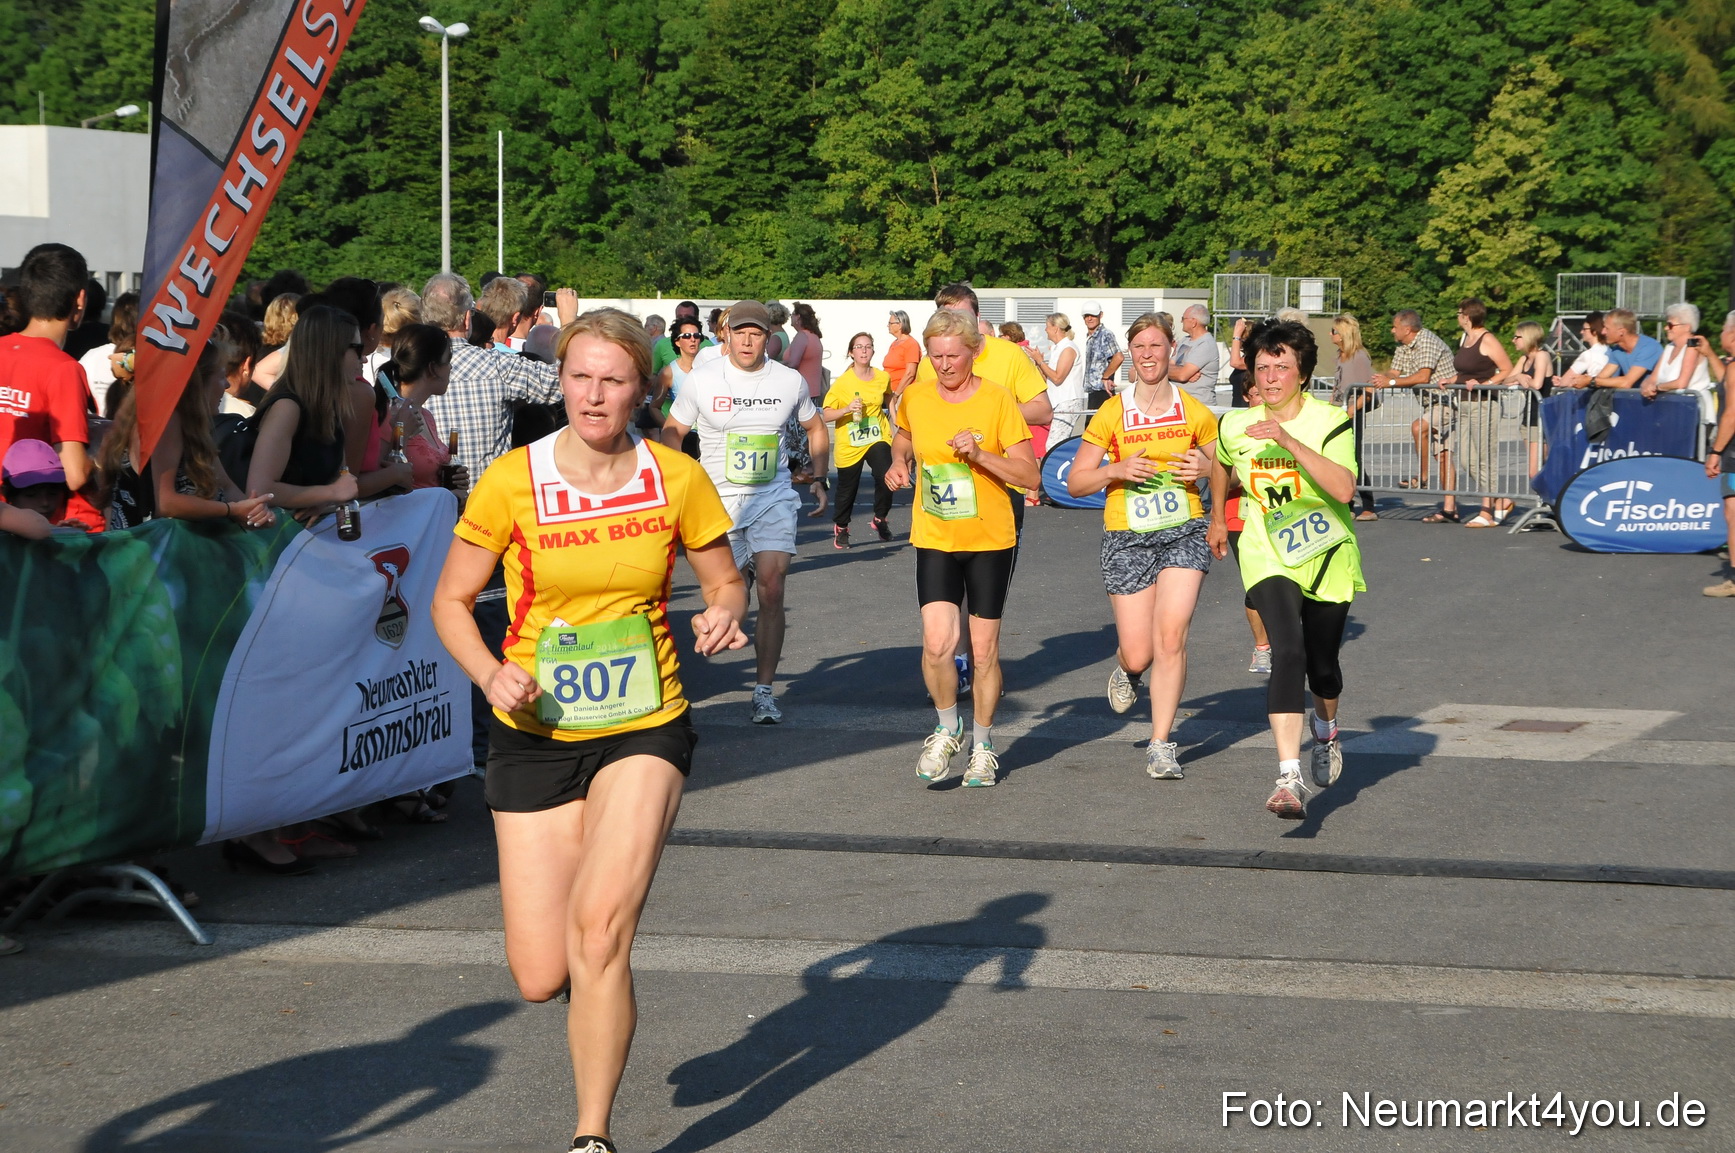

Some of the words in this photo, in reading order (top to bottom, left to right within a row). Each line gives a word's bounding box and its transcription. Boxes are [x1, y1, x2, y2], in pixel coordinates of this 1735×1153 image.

[142, 0, 353, 353] WECHSELS
[733, 397, 782, 407] Egner
[849, 425, 880, 441] 1270
[1123, 431, 1153, 444] MAX
[1157, 428, 1190, 441] BÖGL
[733, 451, 769, 471] 311
[1250, 457, 1298, 470] Müller
[930, 483, 958, 506] 54
[1133, 491, 1179, 518] 818
[1264, 485, 1292, 509] M
[1605, 498, 1720, 520] Fischer
[538, 528, 600, 550] MAX
[607, 515, 672, 541] BÖGL
[1278, 511, 1330, 554] 278
[1615, 521, 1711, 532] AUTOMOBILE
[382, 621, 404, 640] 1628
[551, 641, 594, 653] firmenlauf
[355, 658, 438, 713] Neumarkter
[553, 655, 637, 704] 807
[573, 713, 607, 721] Bauservice
[608, 709, 627, 718] GmbH
[644, 704, 655, 712] KG
[600, 701, 626, 711] Angerer
[338, 694, 452, 775] Lammsbräu
